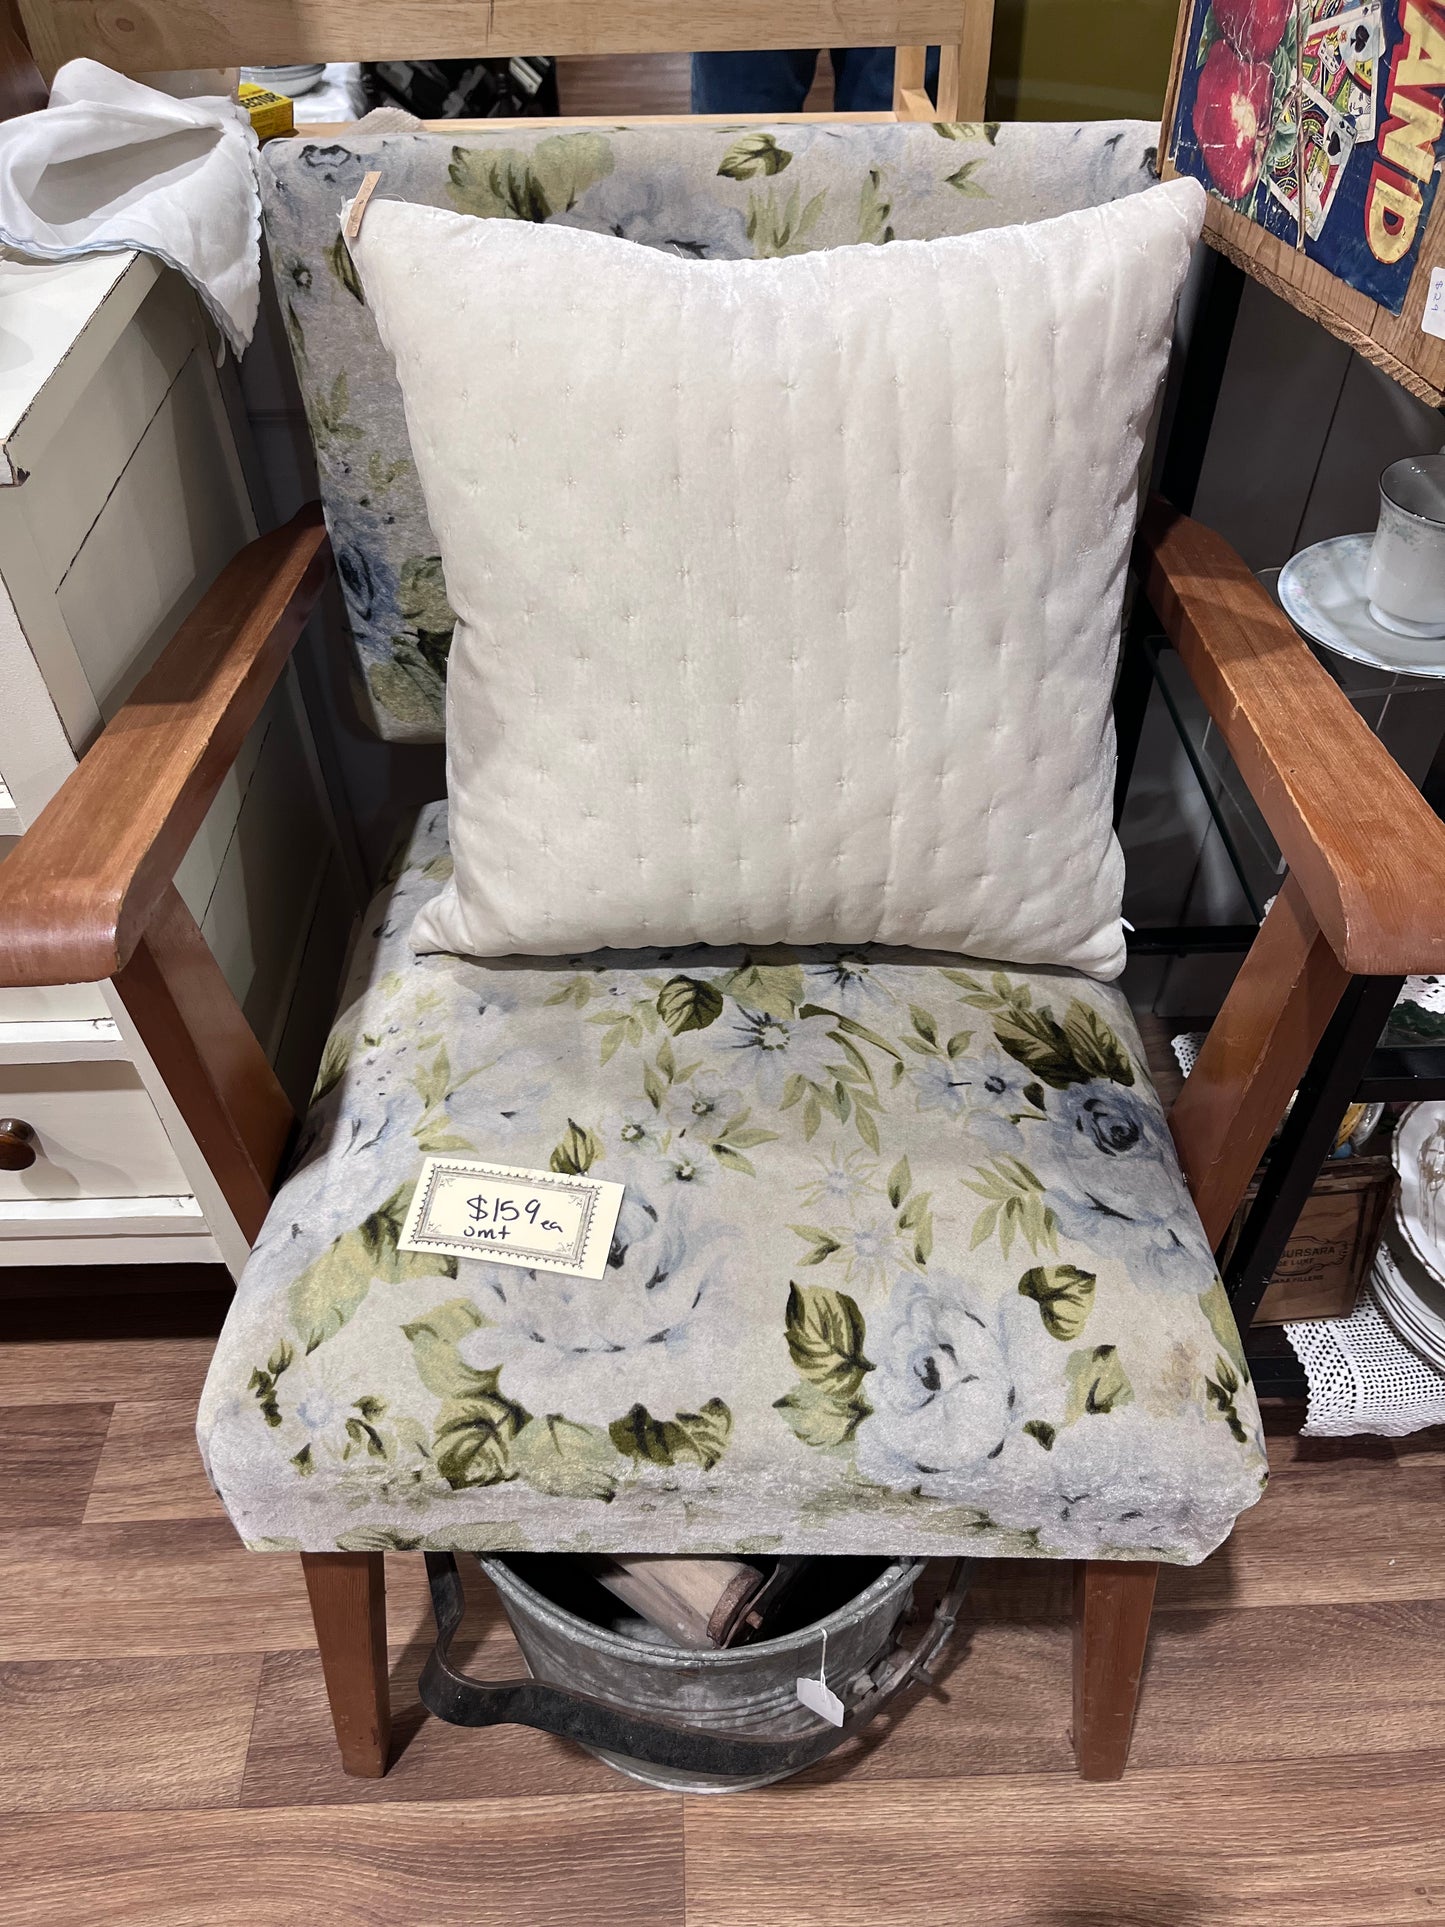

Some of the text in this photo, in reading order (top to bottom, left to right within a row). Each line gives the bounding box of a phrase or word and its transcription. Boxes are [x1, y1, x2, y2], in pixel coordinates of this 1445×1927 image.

[1365, 0, 1445, 264] AND
[466, 1194, 563, 1233] $159 ea
